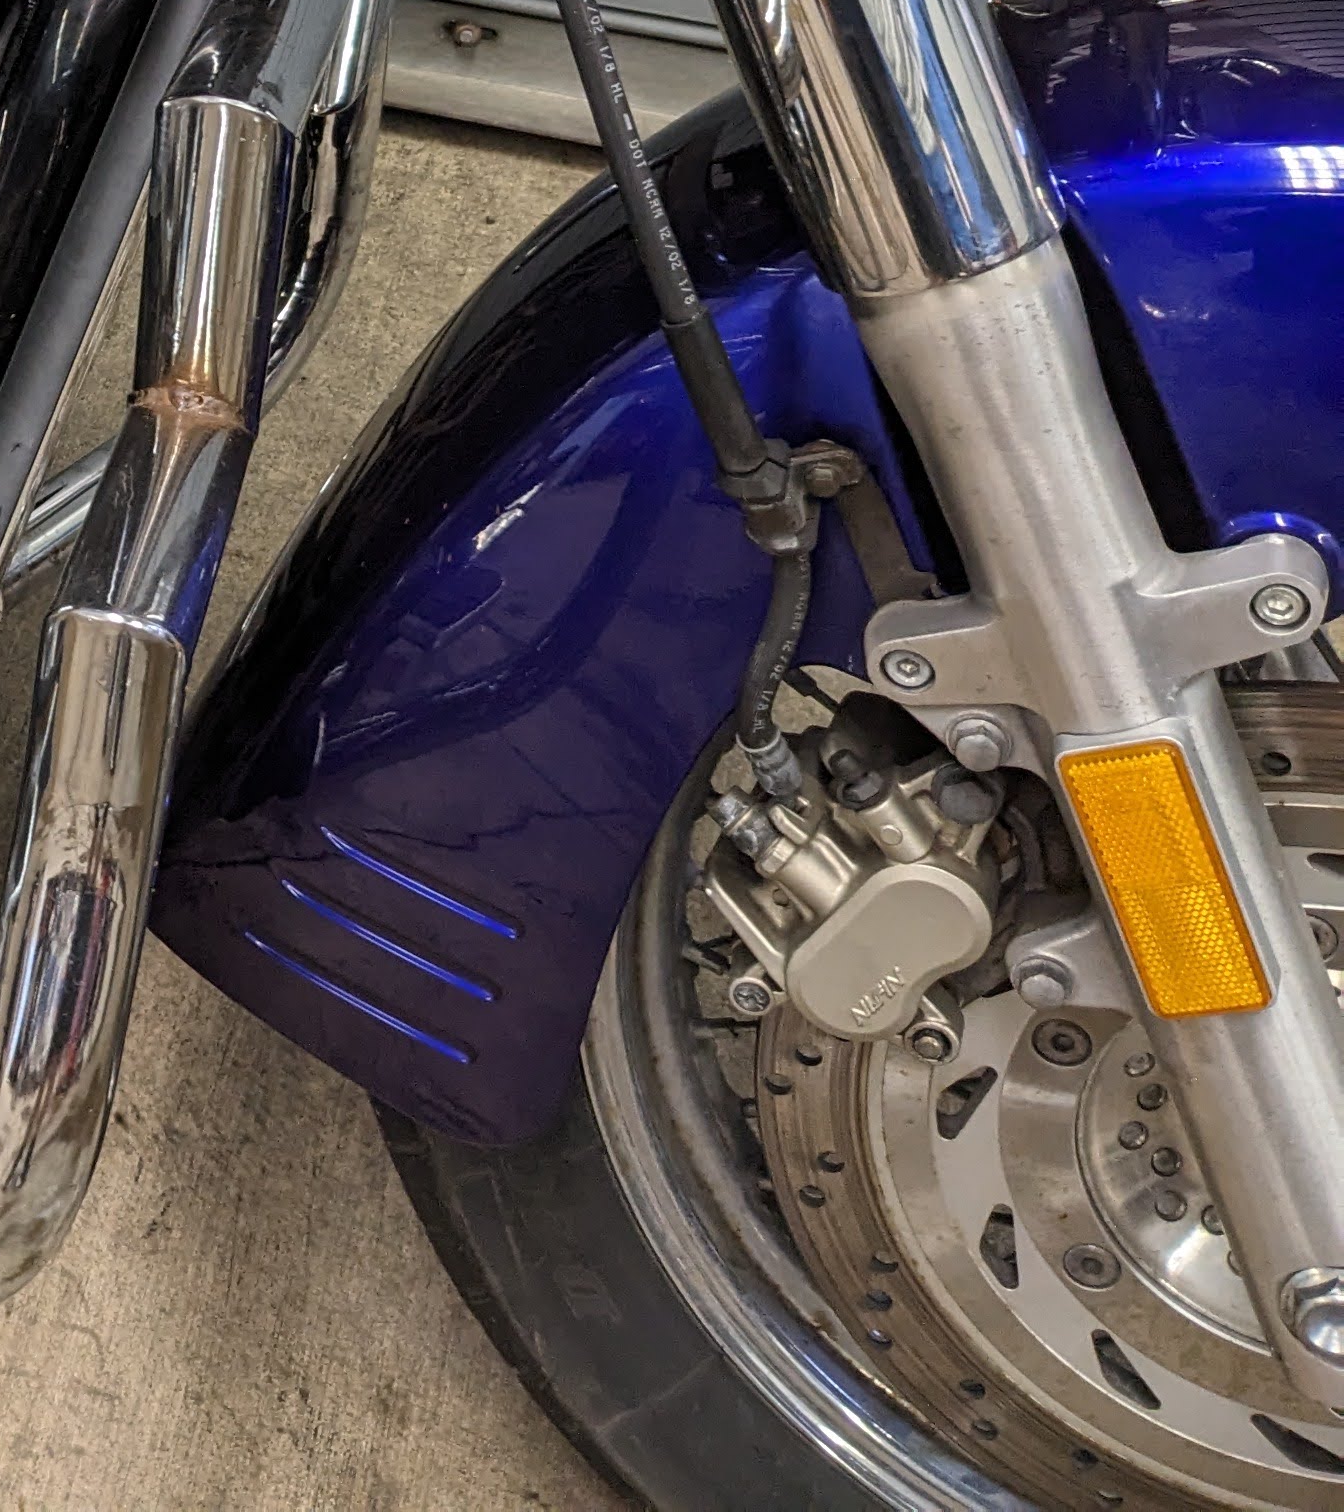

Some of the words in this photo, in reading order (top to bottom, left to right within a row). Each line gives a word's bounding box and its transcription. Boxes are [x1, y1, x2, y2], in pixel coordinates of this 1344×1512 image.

[599, 45, 616, 73] 1/8
[610, 82, 624, 104] HL
[629, 138, 647, 168] DOT
[641, 177, 665, 219] NCRN
[659, 225, 683, 271] 12/02
[678, 277, 696, 306] 1/8
